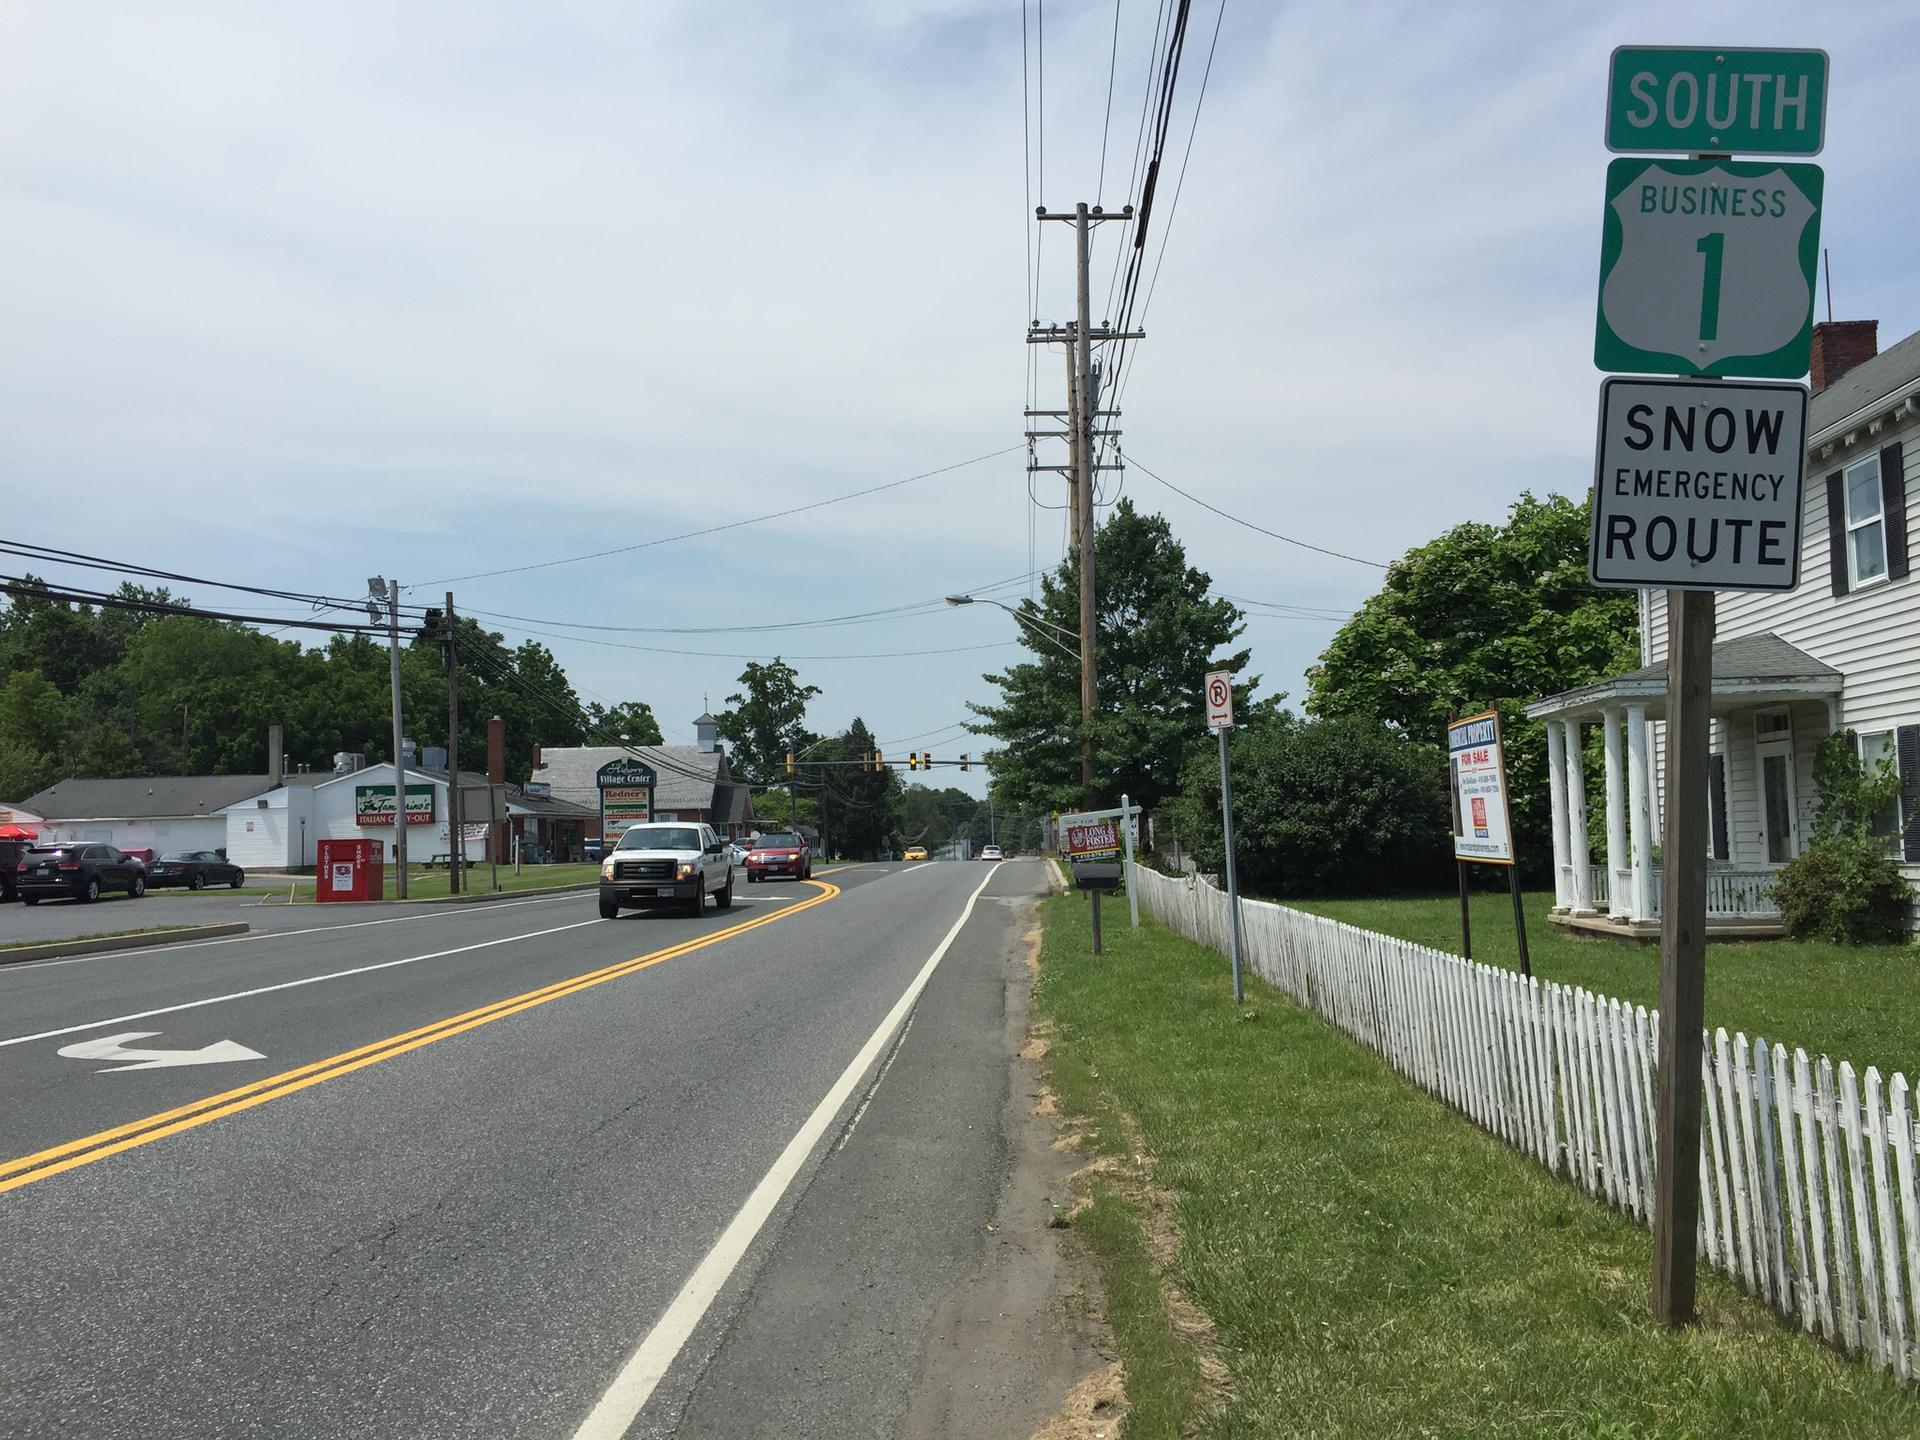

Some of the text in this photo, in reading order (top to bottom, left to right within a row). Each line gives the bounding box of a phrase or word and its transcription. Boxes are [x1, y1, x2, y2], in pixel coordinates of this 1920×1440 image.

[1626, 71, 1808, 130] SOUTH
[1640, 185, 1786, 218] BUSINESS
[1696, 232, 1725, 341] 1
[1624, 403, 1784, 455] SNOW
[1615, 468, 1784, 501] EMERGENCY
[1605, 514, 1787, 566] ROUTE
[1467, 719, 1495, 744] PROPERTY
[1461, 749, 1489, 766] FOR SALE
[600, 774, 652, 784] Village Center
[605, 790, 647, 798] Redner's
[359, 814, 430, 823] ITALIAN CY-OUT
[1084, 826, 1106, 837] LONG
[1086, 833, 1116, 846] FOSTER
